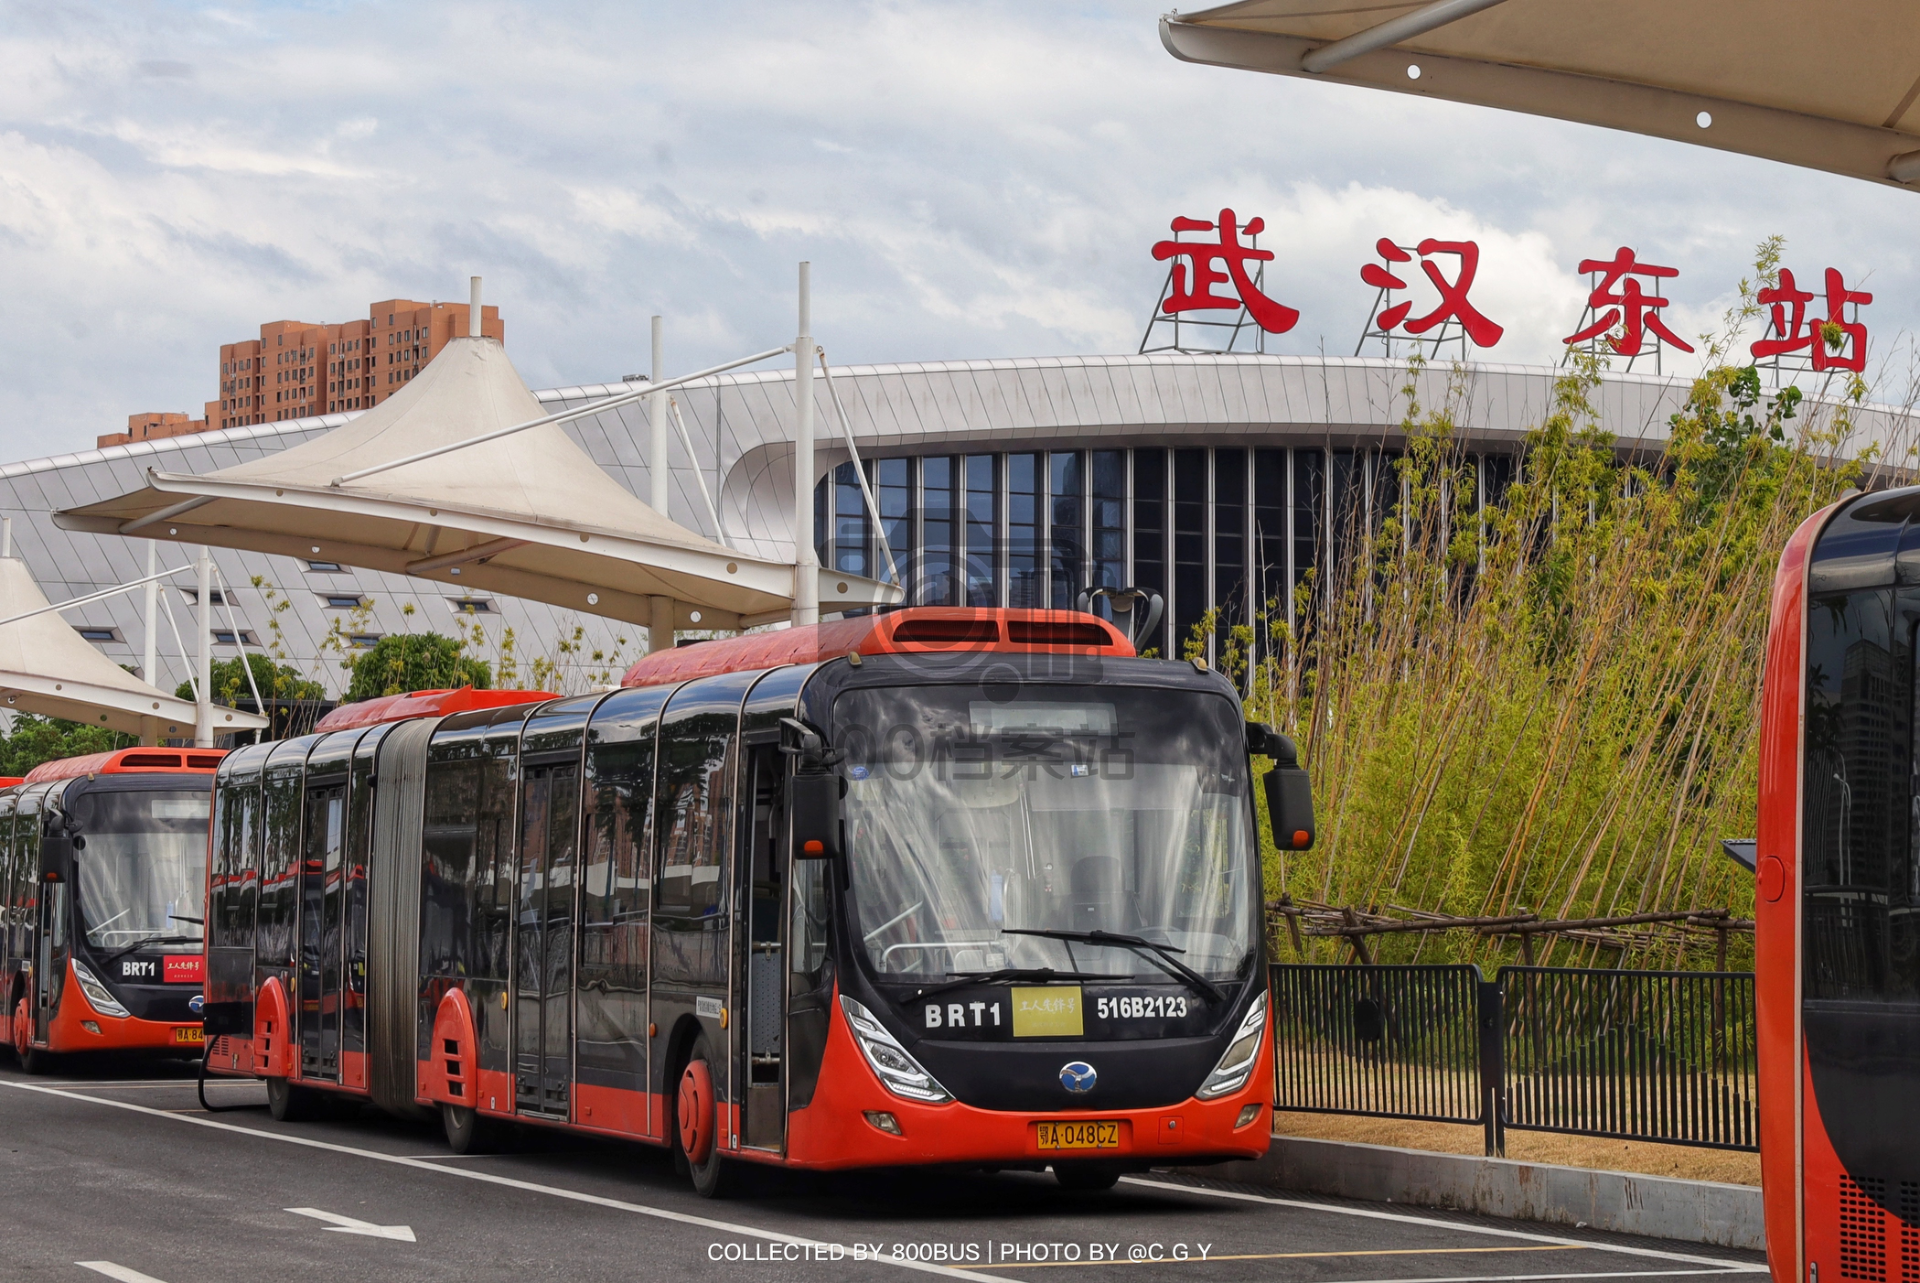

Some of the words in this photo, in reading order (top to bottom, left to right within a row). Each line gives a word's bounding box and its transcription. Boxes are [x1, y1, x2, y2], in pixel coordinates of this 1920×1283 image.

[1151, 207, 1874, 373] 武汉东站
[122, 962, 155, 976] BRT1
[925, 1002, 1001, 1028] BRT1
[1020, 997, 1076, 1014] 工人先锋号
[1097, 997, 1187, 1018] 516B2123
